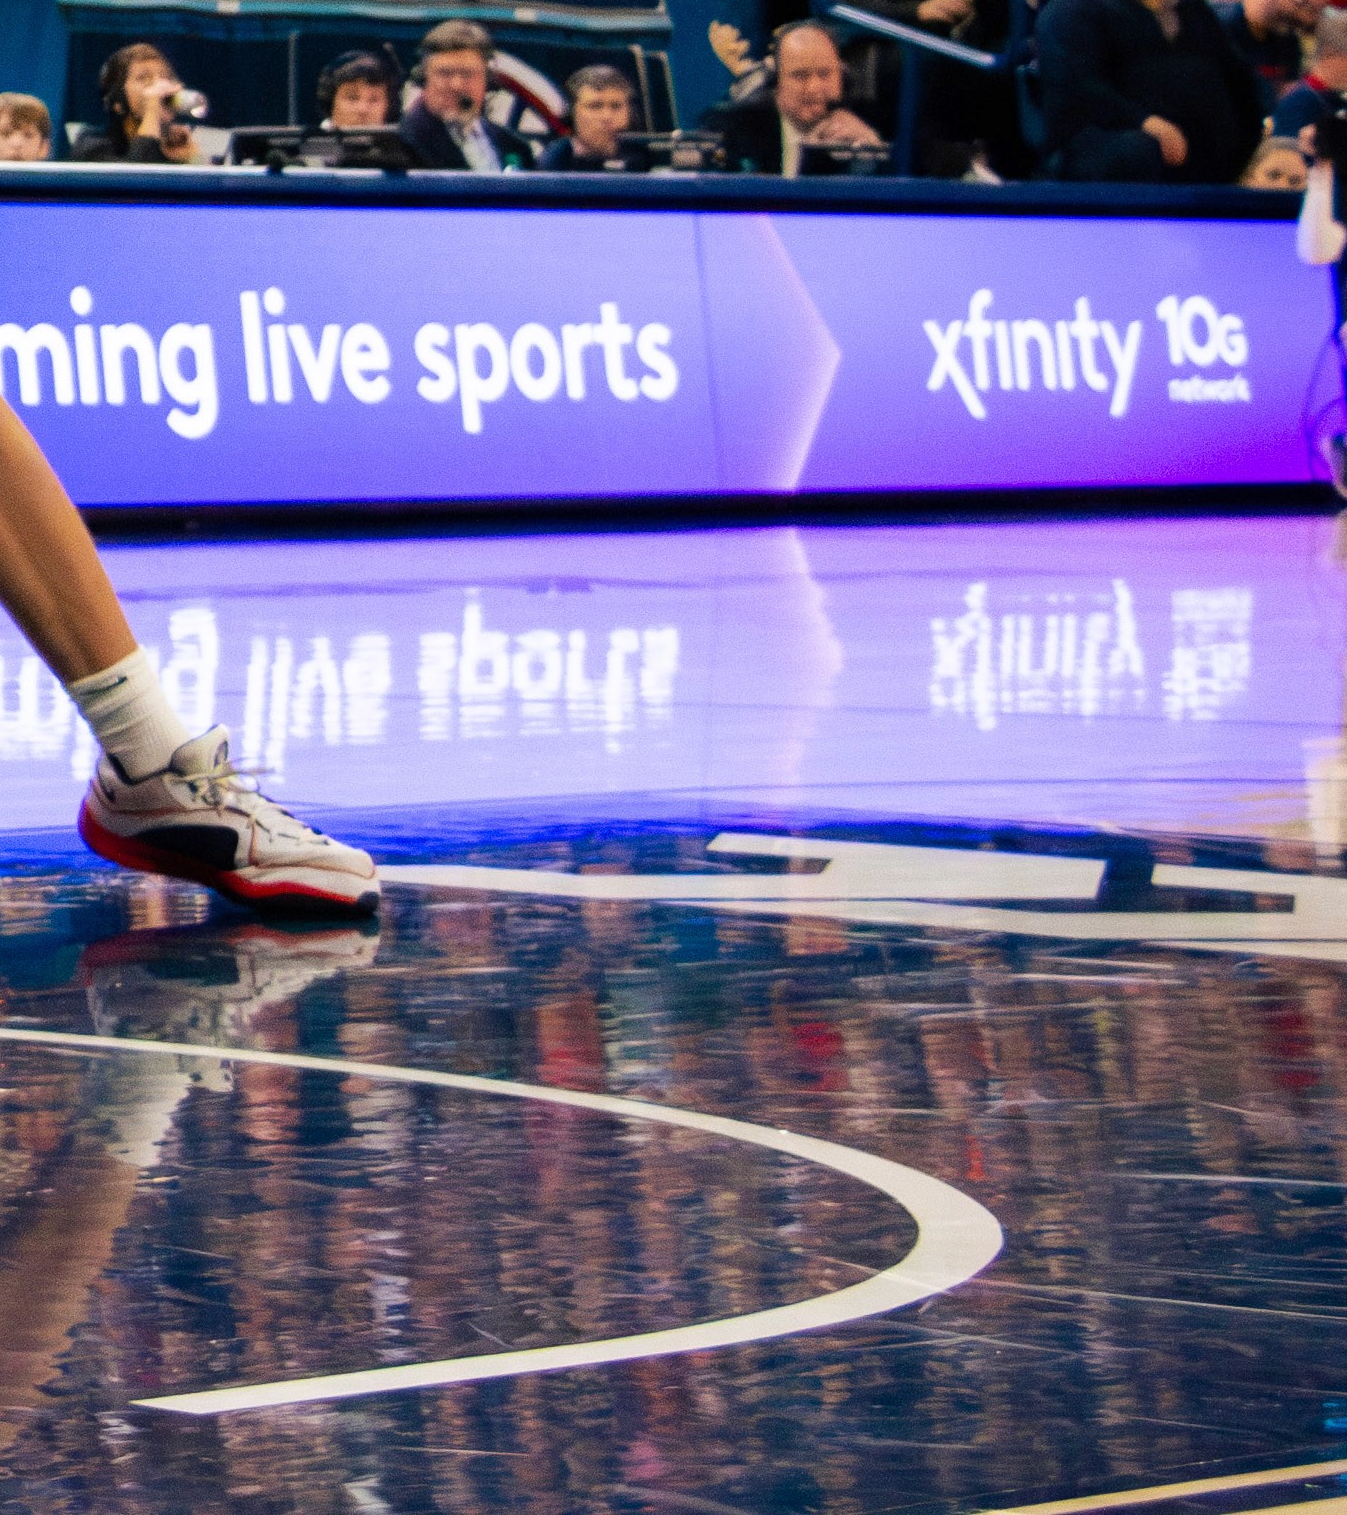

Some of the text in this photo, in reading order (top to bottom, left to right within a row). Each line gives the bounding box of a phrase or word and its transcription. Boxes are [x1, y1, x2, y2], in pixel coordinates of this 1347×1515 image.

[239, 285, 392, 404] live
[413, 301, 679, 434] sports
[922, 287, 1249, 420] xfinity 10G
